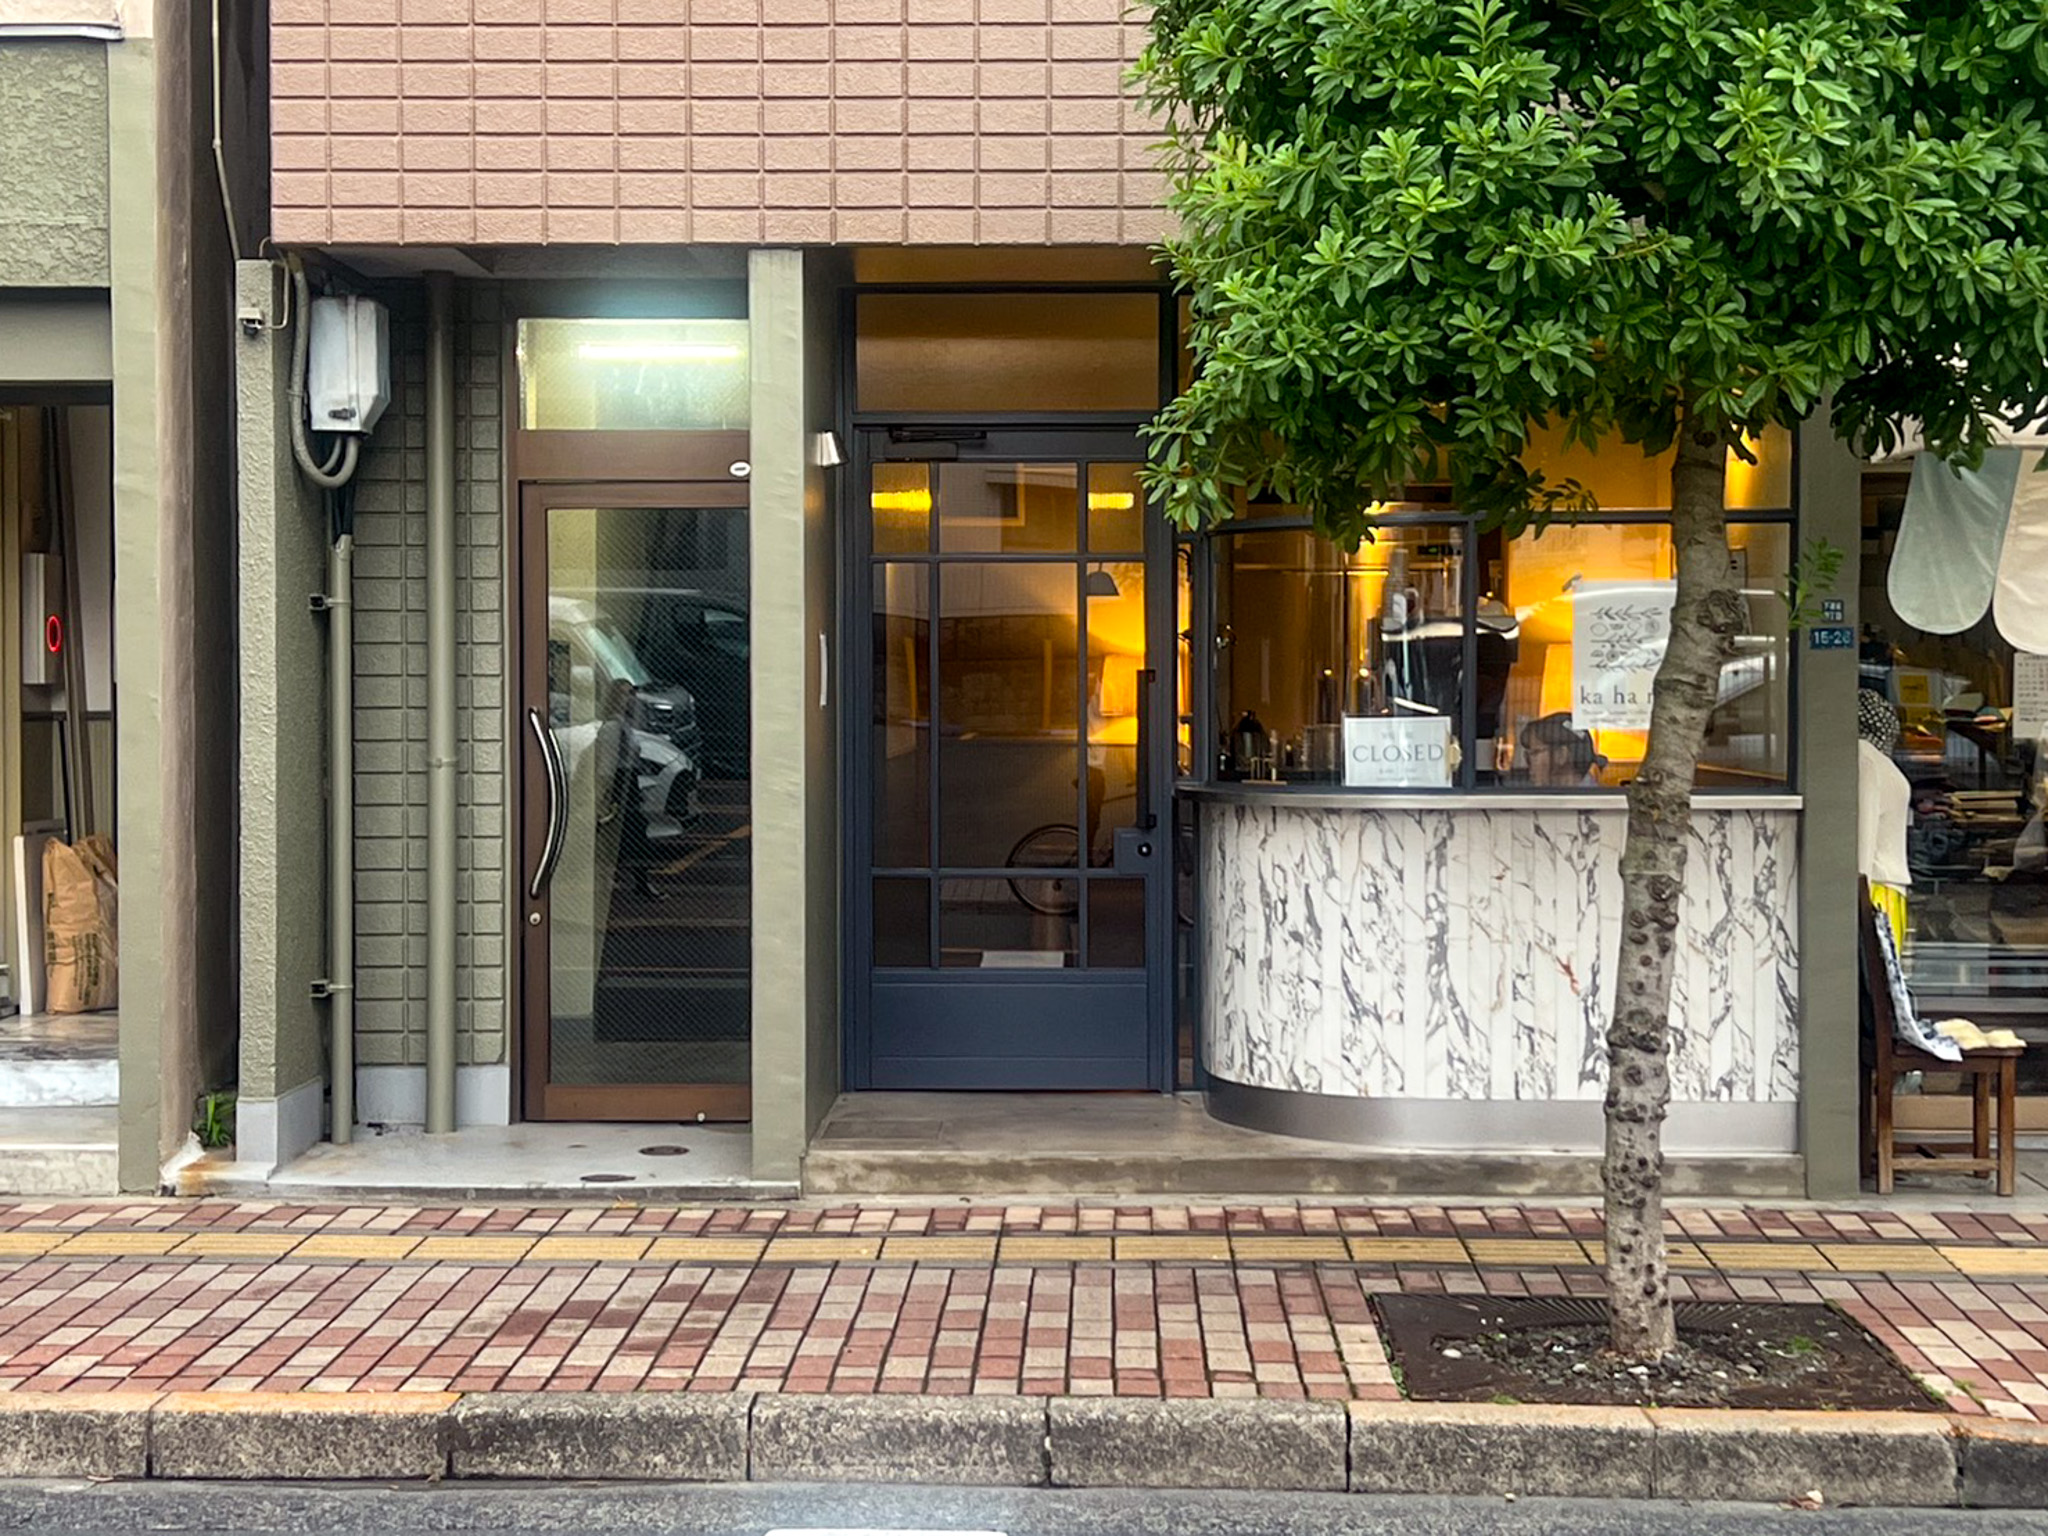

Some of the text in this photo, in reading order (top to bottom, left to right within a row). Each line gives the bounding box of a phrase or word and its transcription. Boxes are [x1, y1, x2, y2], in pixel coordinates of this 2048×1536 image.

[1580, 685, 1603, 704] ka
[1613, 685, 1638, 704] ha
[1352, 743, 1444, 763] CLOSED
